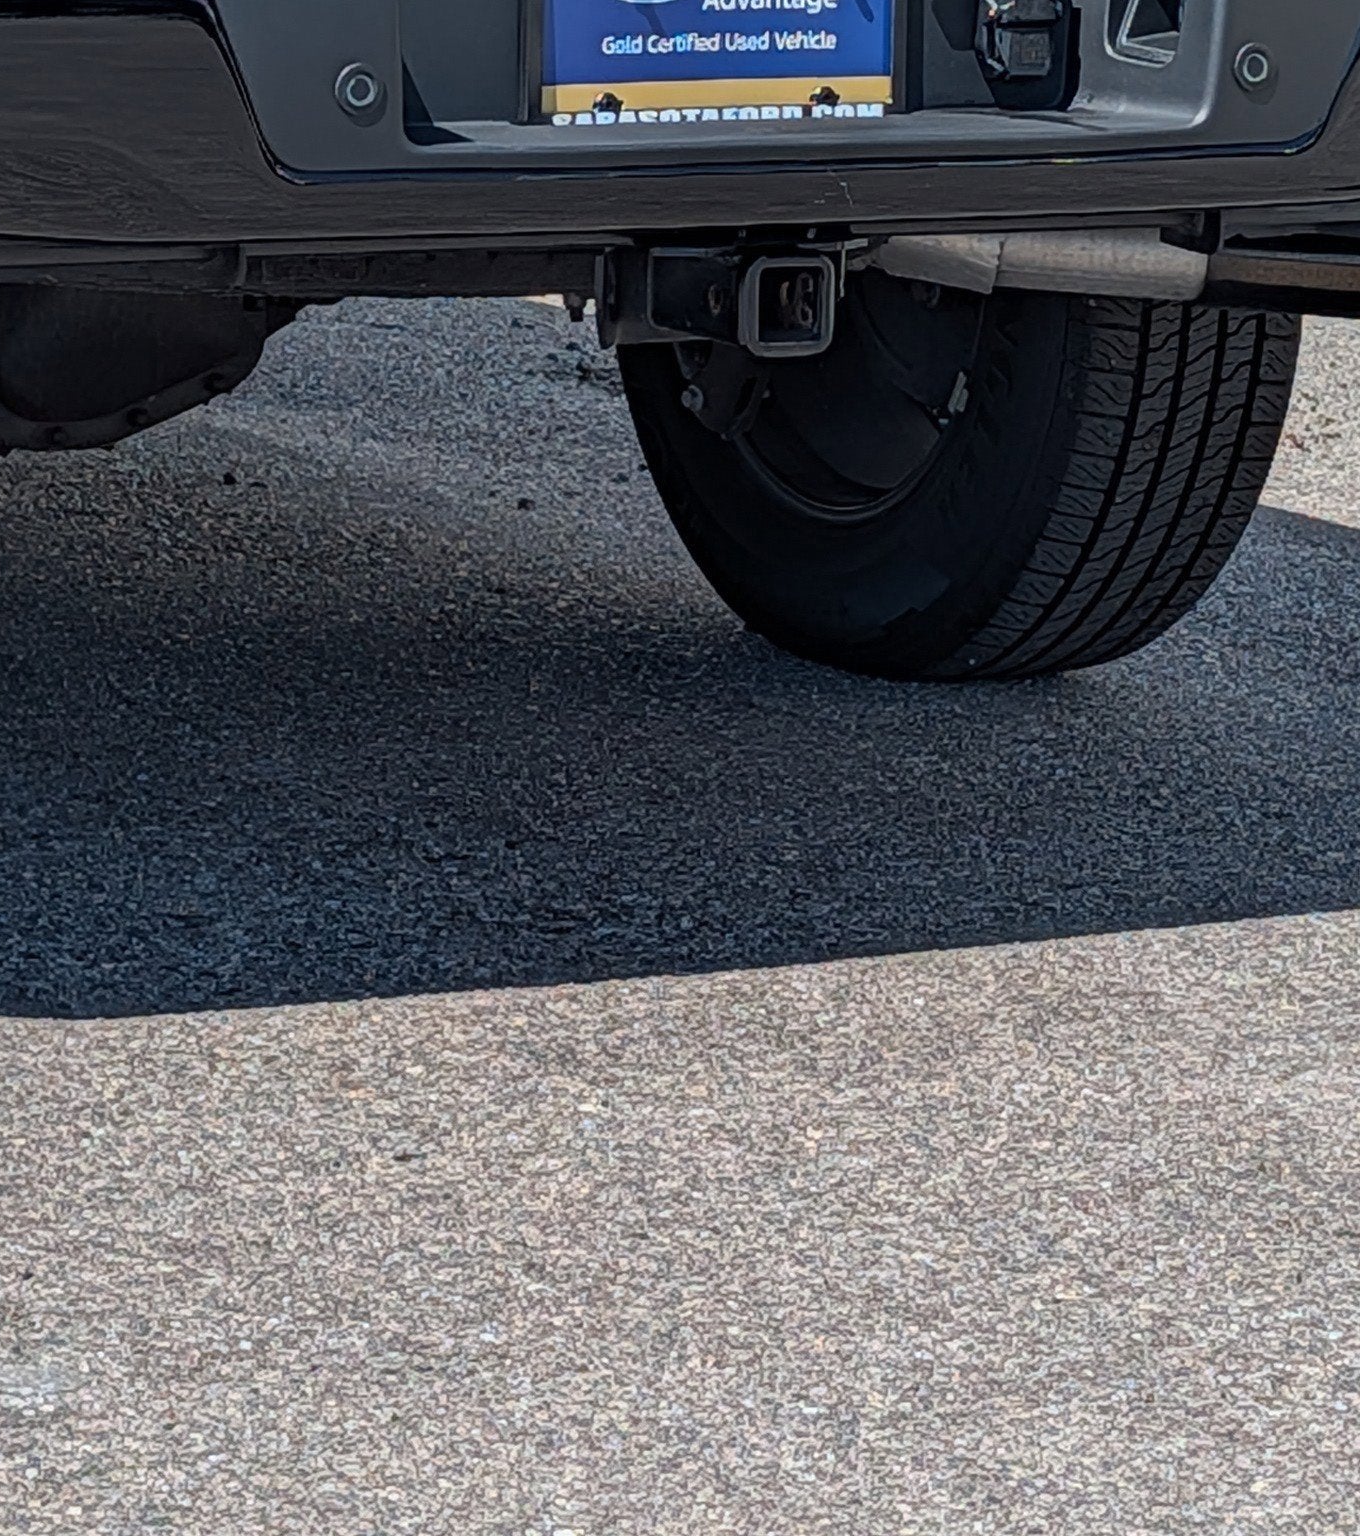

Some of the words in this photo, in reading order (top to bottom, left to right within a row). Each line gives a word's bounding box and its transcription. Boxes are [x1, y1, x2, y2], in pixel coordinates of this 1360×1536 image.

[601, 35, 642, 54] Gold
[647, 32, 720, 53] Certified
[725, 30, 770, 51] Used
[774, 29, 837, 51] Vehicle
